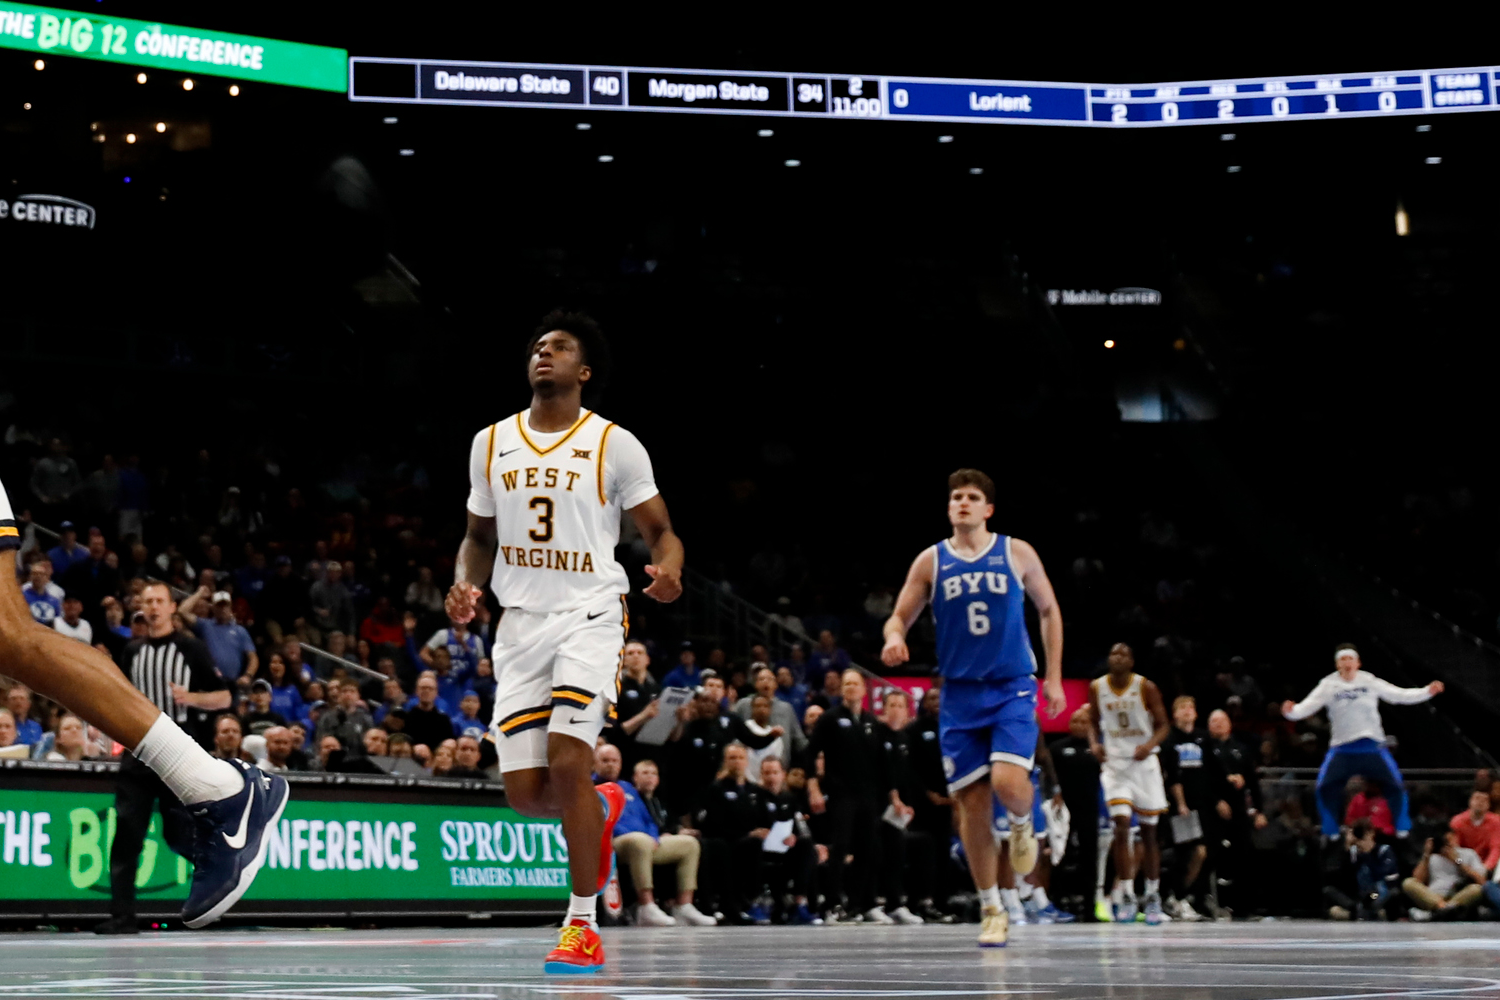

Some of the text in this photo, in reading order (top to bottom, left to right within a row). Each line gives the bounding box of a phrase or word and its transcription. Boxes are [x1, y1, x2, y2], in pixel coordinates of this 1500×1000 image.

[37, 14, 94, 52] BIG
[100, 23, 127, 55] 12
[134, 30, 264, 70] CONFERENCE
[434, 71, 824, 103] Delaware State 40 Morgan State 34
[1435, 73, 1481, 89] TEAM
[833, 97, 881, 116] 11:00
[893, 88, 1033, 112] 0 Lorient
[1111, 91, 1397, 124] 2 0 2 0 1 0
[1434, 90, 1484, 106] STATS
[11, 201, 88, 226] CENTER
[501, 467, 580, 492] WEST
[528, 496, 554, 543] 3
[501, 546, 594, 573] VRGINIA
[941, 571, 1008, 600] BYU
[966, 601, 990, 636] 6
[259, 819, 419, 871] NFERENCE
[440, 820, 569, 863] SPROUTS
[450, 867, 569, 887] FARMERS MARKET
